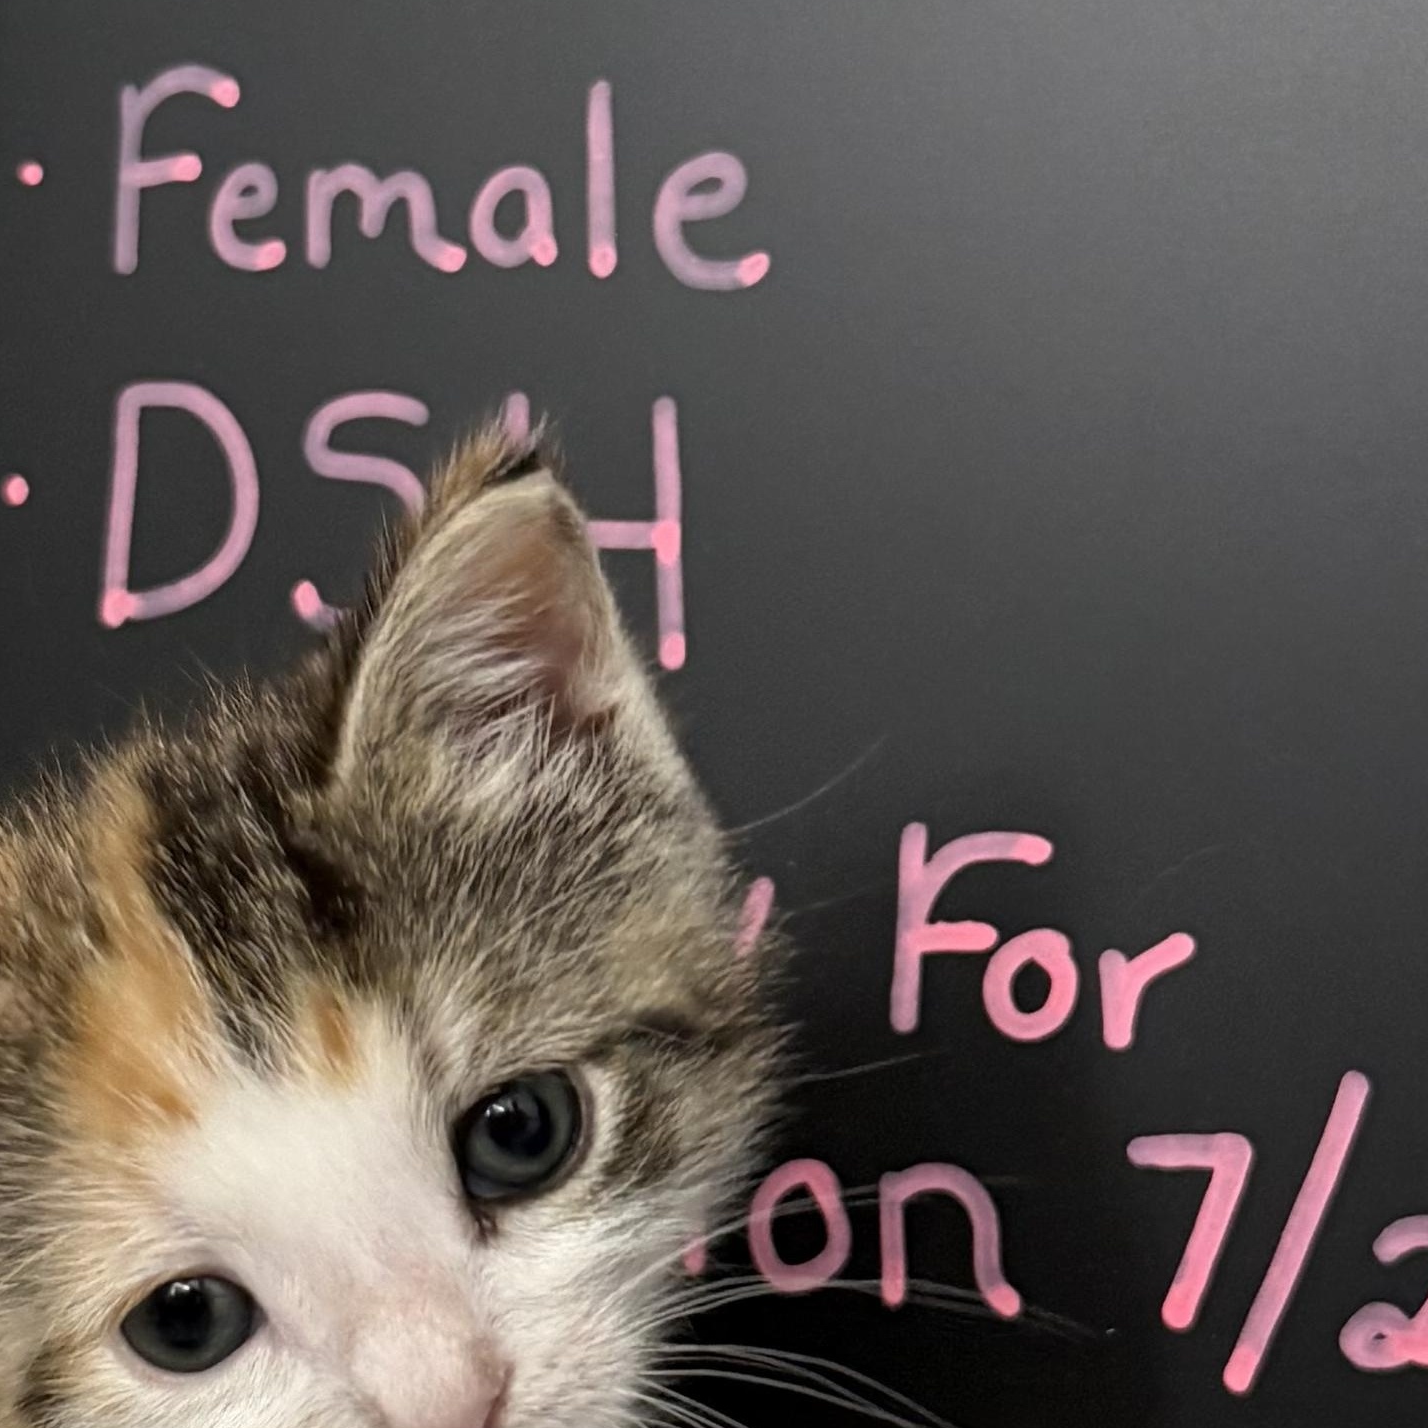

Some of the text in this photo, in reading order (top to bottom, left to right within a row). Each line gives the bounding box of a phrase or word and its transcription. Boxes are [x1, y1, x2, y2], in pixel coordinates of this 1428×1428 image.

[113, 64, 771, 291] Female
[97, 381, 687, 672] DSH
[889, 822, 1197, 1052] For
